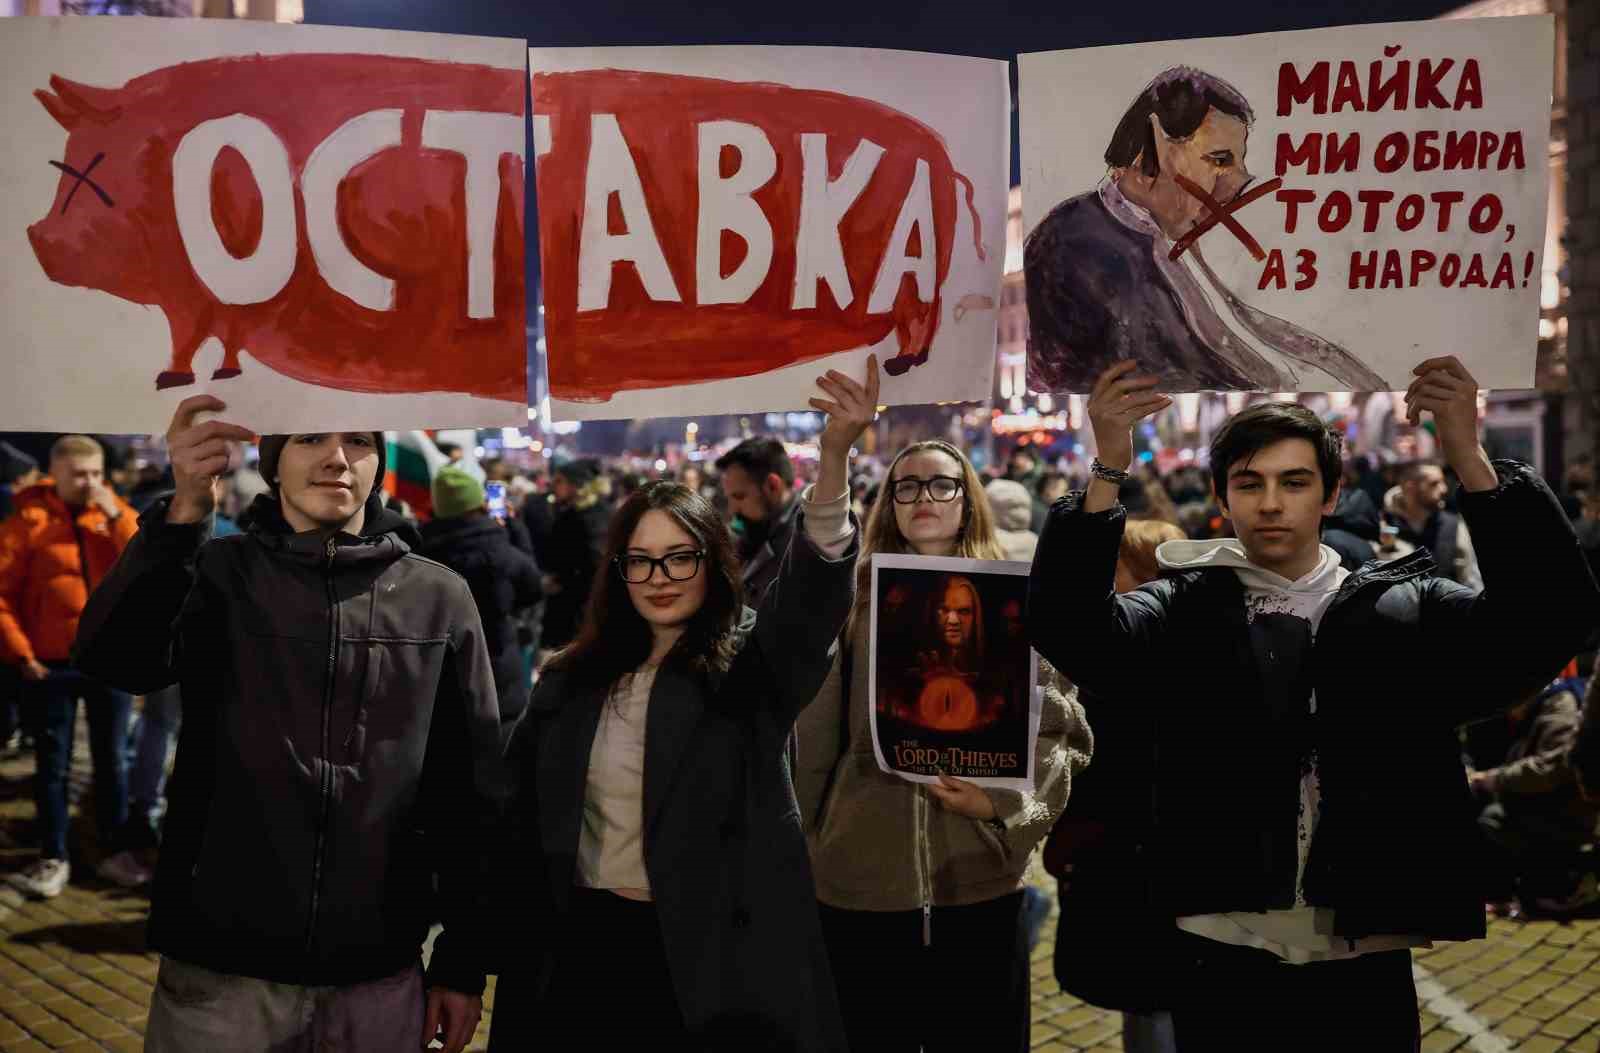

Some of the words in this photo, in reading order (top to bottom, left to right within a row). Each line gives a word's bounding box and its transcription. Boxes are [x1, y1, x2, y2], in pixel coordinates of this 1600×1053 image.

[1276, 45, 1483, 116] МАЙКА
[1275, 132, 1360, 176] МИ
[1374, 130, 1525, 174] ОБИРА
[172, 108, 937, 319] ОСТАВКА
[1276, 189, 1516, 243] ТОТОТО,
[1257, 249, 1318, 291] АЗ
[1348, 249, 1534, 290] НАРОДА!
[895, 745, 939, 767] LORD
[948, 747, 1017, 768] THIEVES
